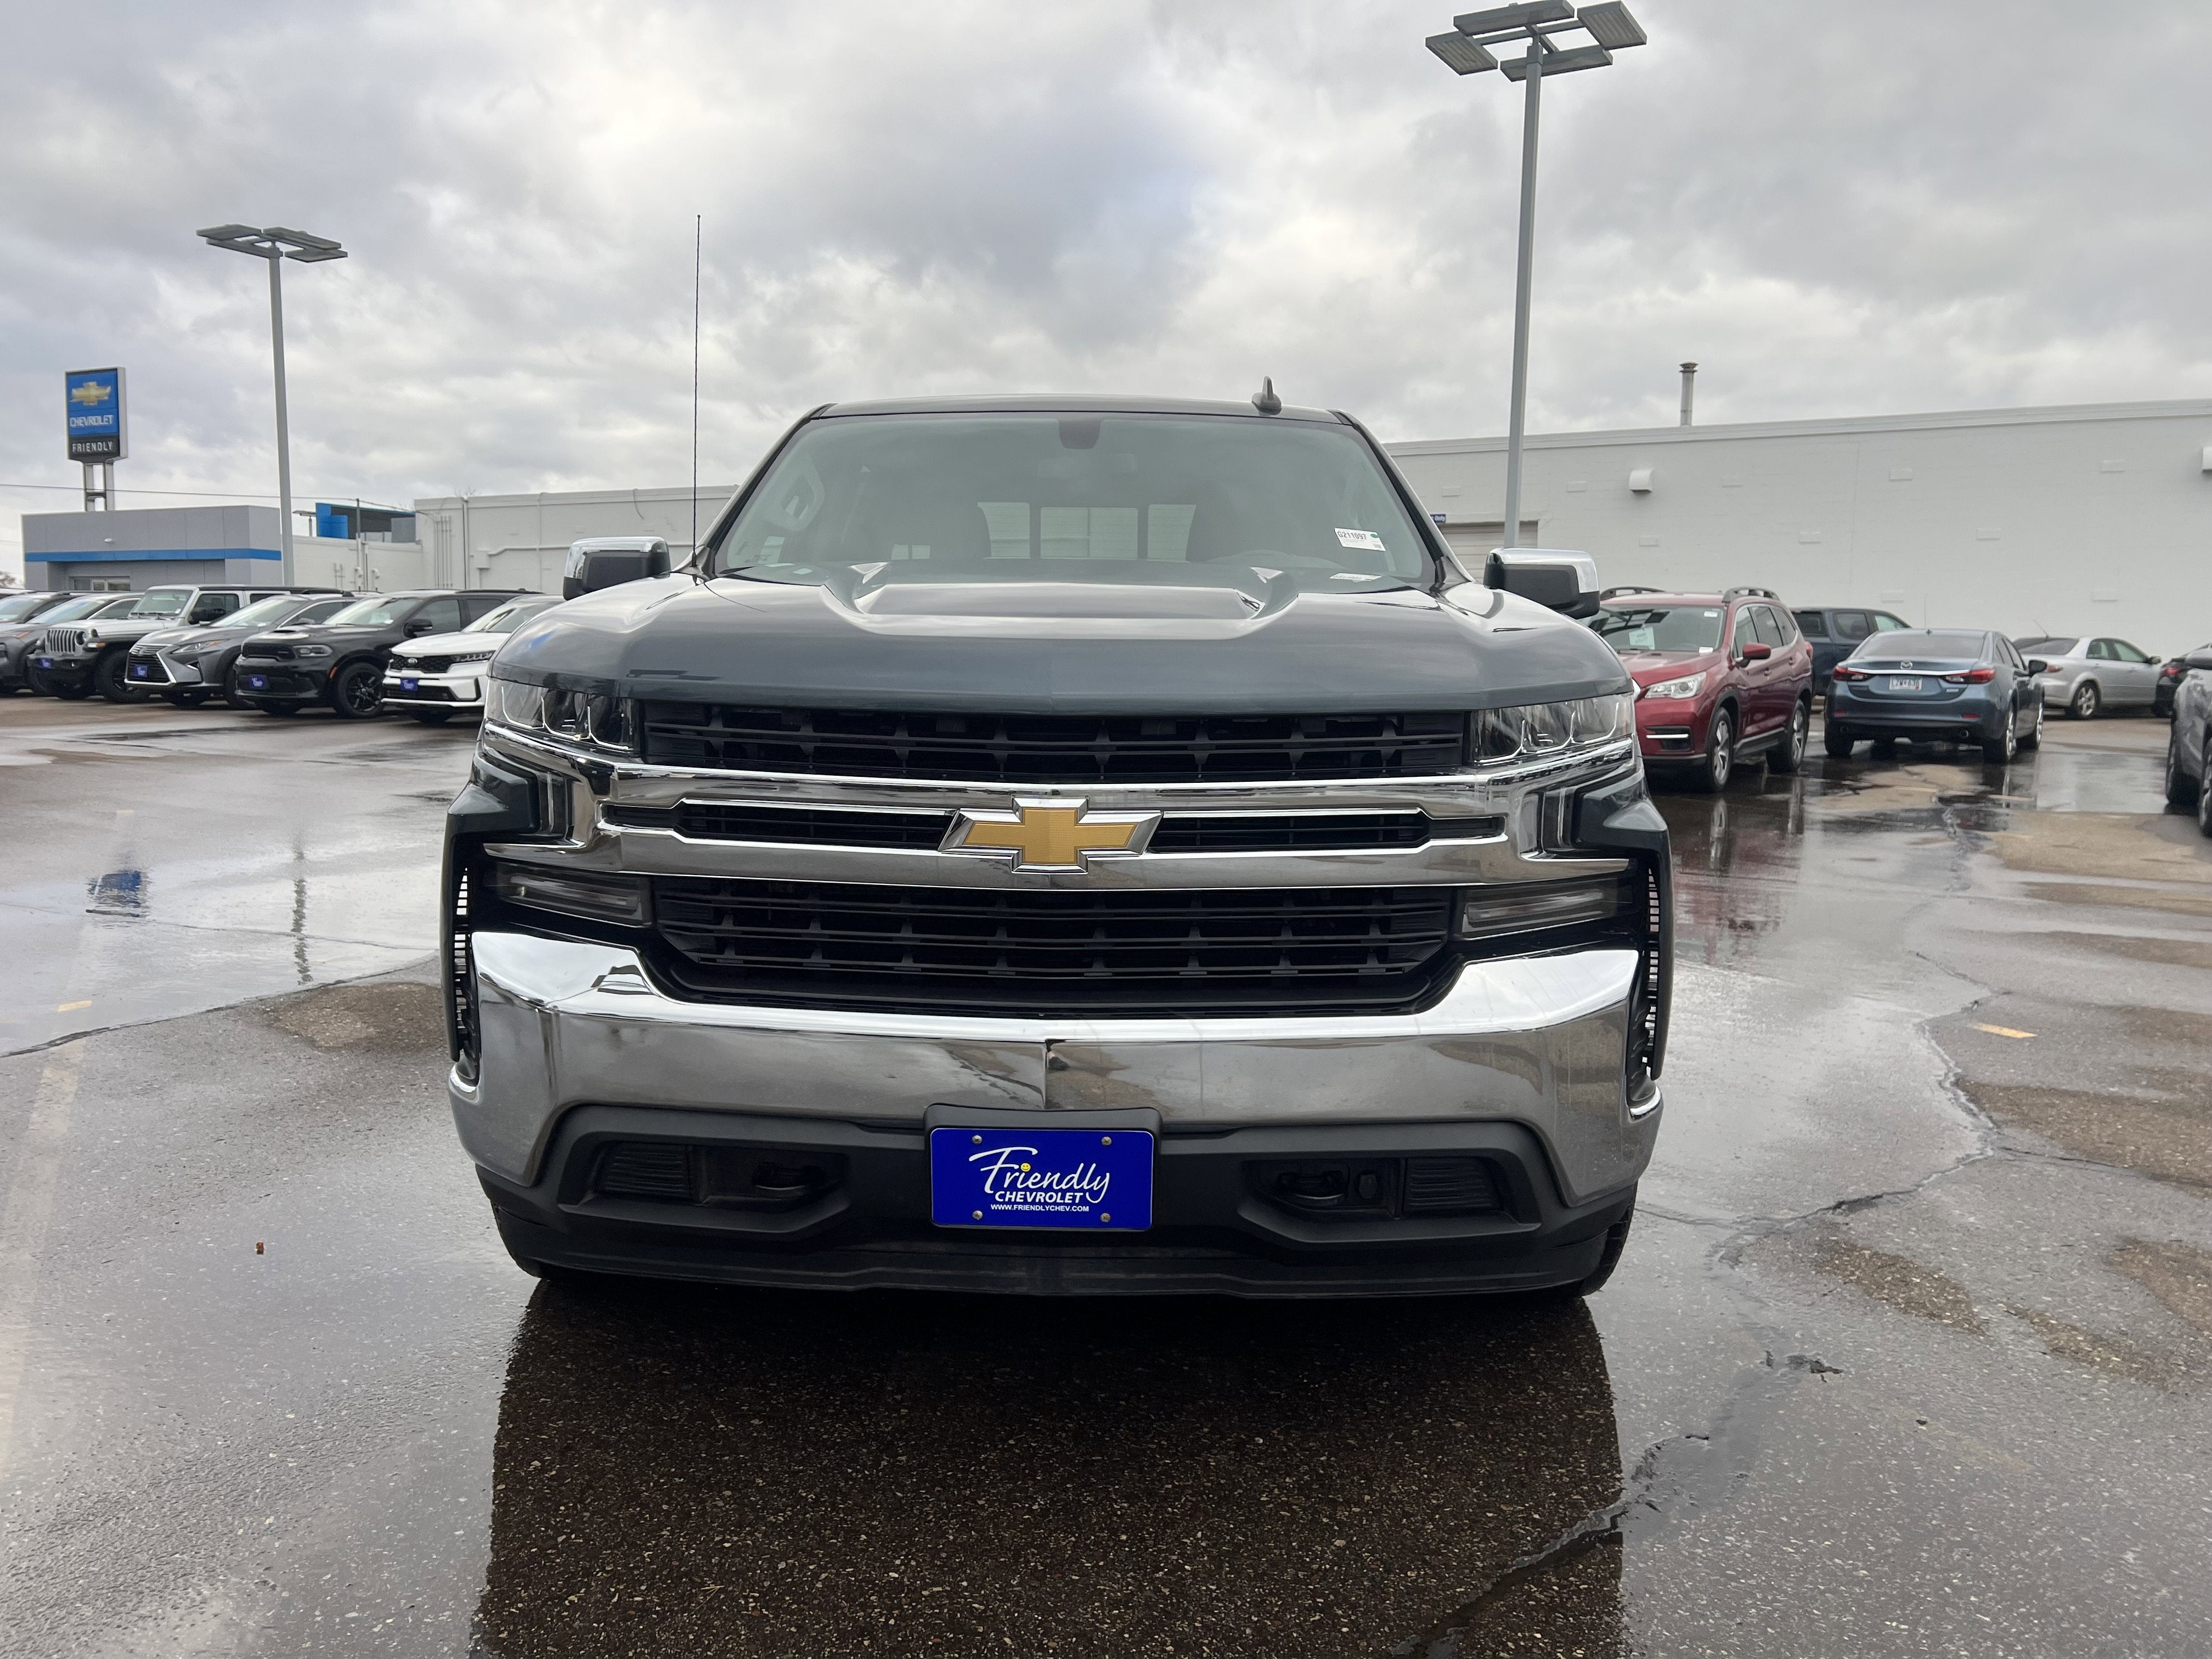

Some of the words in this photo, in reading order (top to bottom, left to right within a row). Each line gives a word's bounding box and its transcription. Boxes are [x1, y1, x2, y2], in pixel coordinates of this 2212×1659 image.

[70, 415, 114, 427] CHEVROLET
[72, 441, 112, 453] FRIENDLY
[1337, 531, 1367, 540] G211097
[968, 1146, 1110, 1203] Friendly
[995, 1190, 1084, 1203] CHEVROLET
[990, 1204, 1090, 1212] WWW.FRIENDLYCHEV.COM
